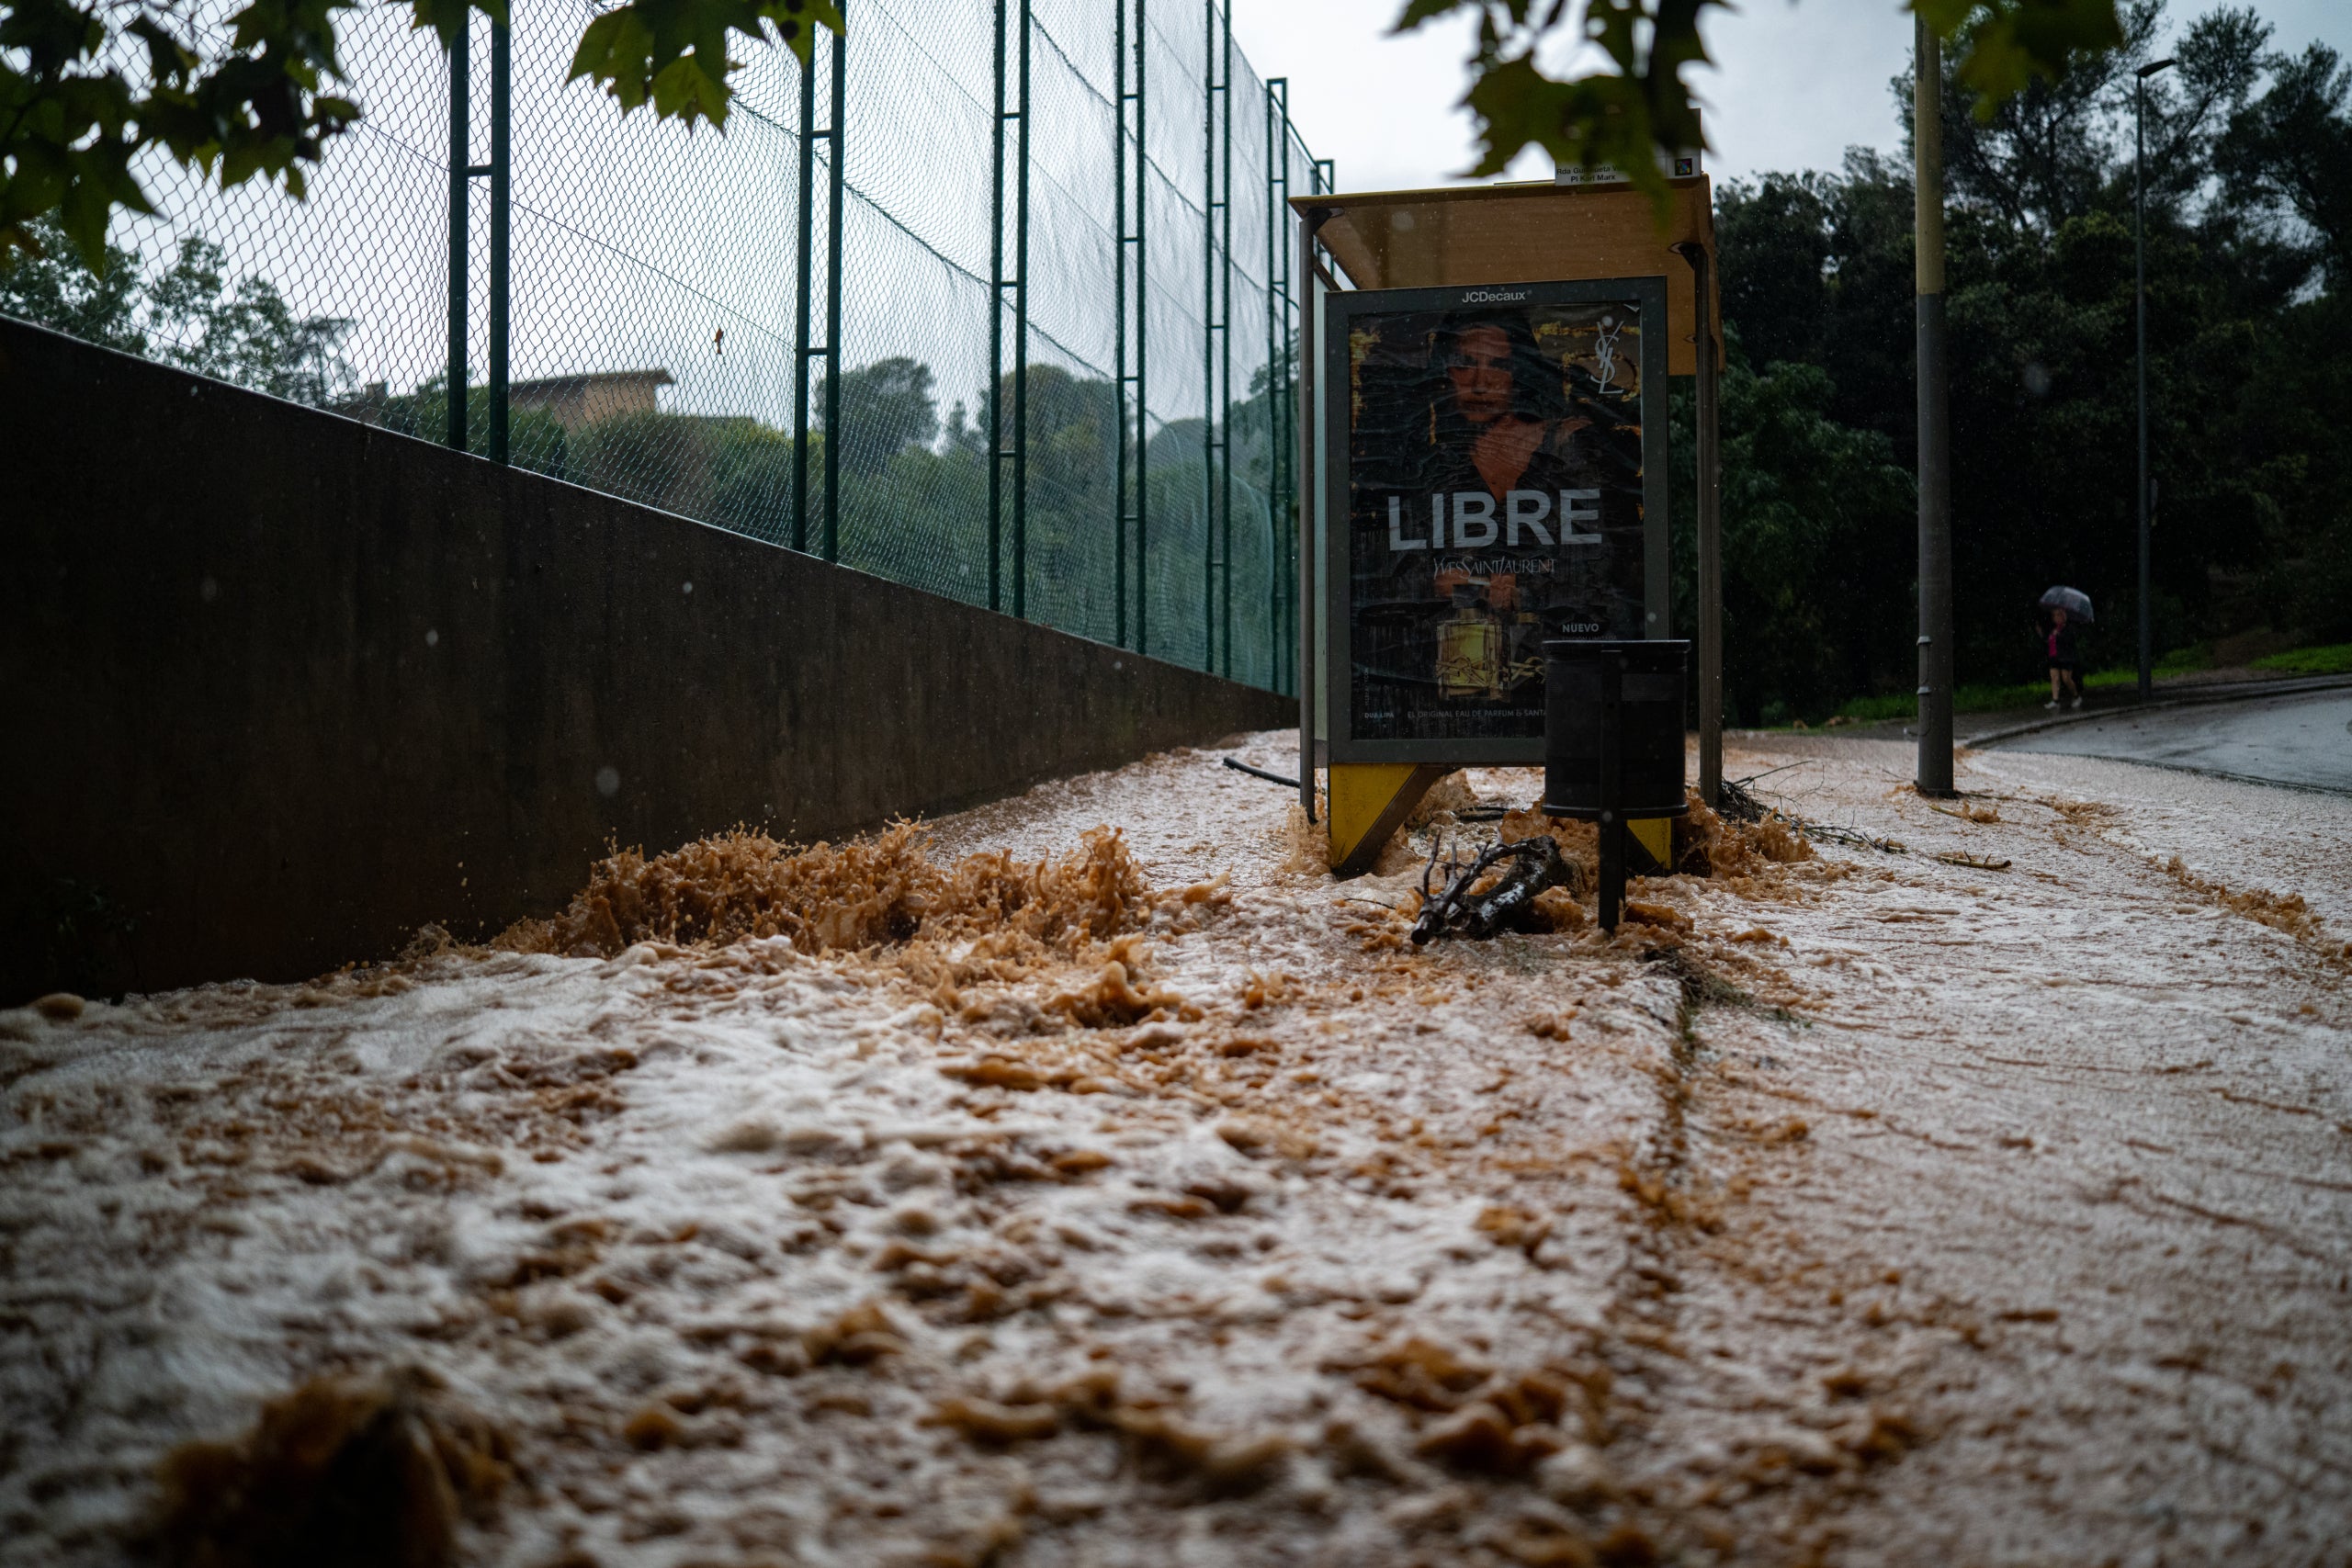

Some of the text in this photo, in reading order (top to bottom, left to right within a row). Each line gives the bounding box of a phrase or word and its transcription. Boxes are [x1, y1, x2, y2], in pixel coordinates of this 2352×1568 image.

[1462, 290, 1526, 303] JCDecaux
[1387, 488, 1602, 551] LIBRE
[1562, 623, 1600, 633] NUEVO
[1417, 710, 1453, 718] ORIGINAL
[1454, 710, 1470, 718] EAU
[1484, 709, 1514, 717] PARFUM
